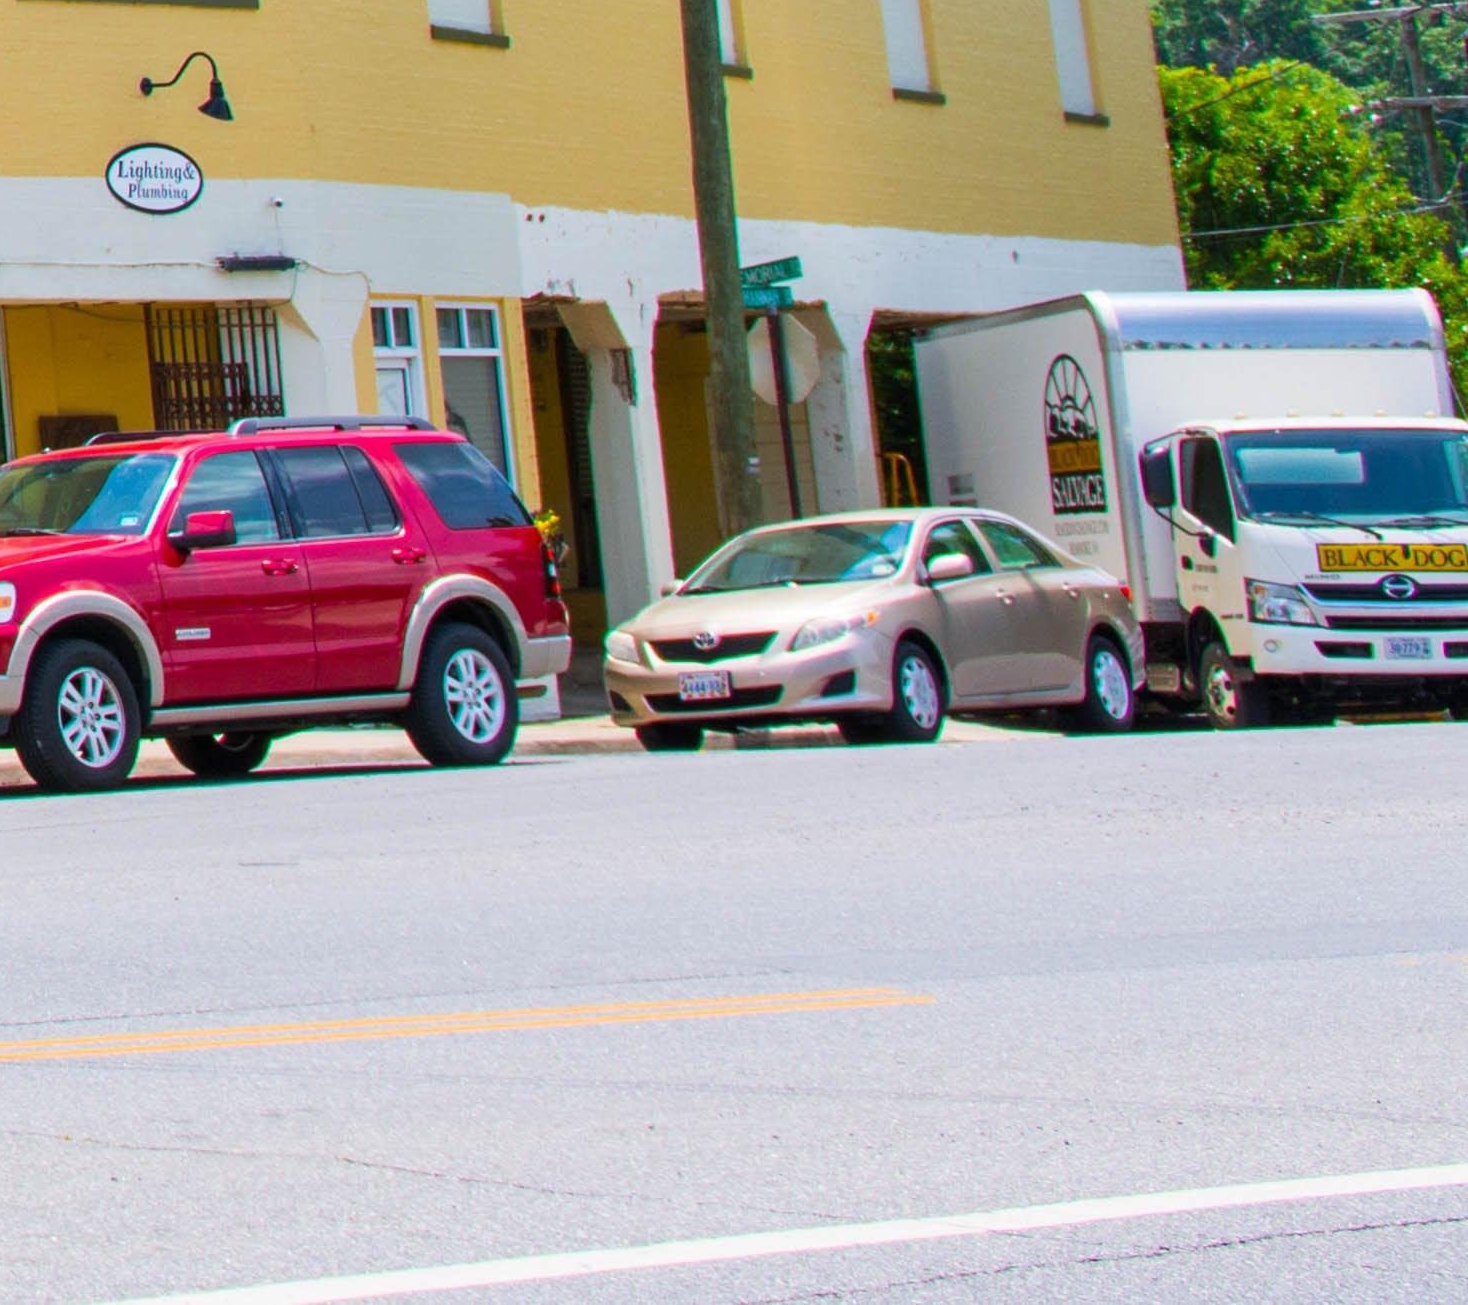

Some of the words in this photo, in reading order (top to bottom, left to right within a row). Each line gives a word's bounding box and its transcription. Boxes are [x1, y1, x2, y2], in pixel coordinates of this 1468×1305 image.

[128, 183, 189, 203] Plumbing
[1053, 474, 1104, 508] SALVAGE
[1324, 548, 1399, 568] BLACK
[1415, 548, 1465, 568] DOG
